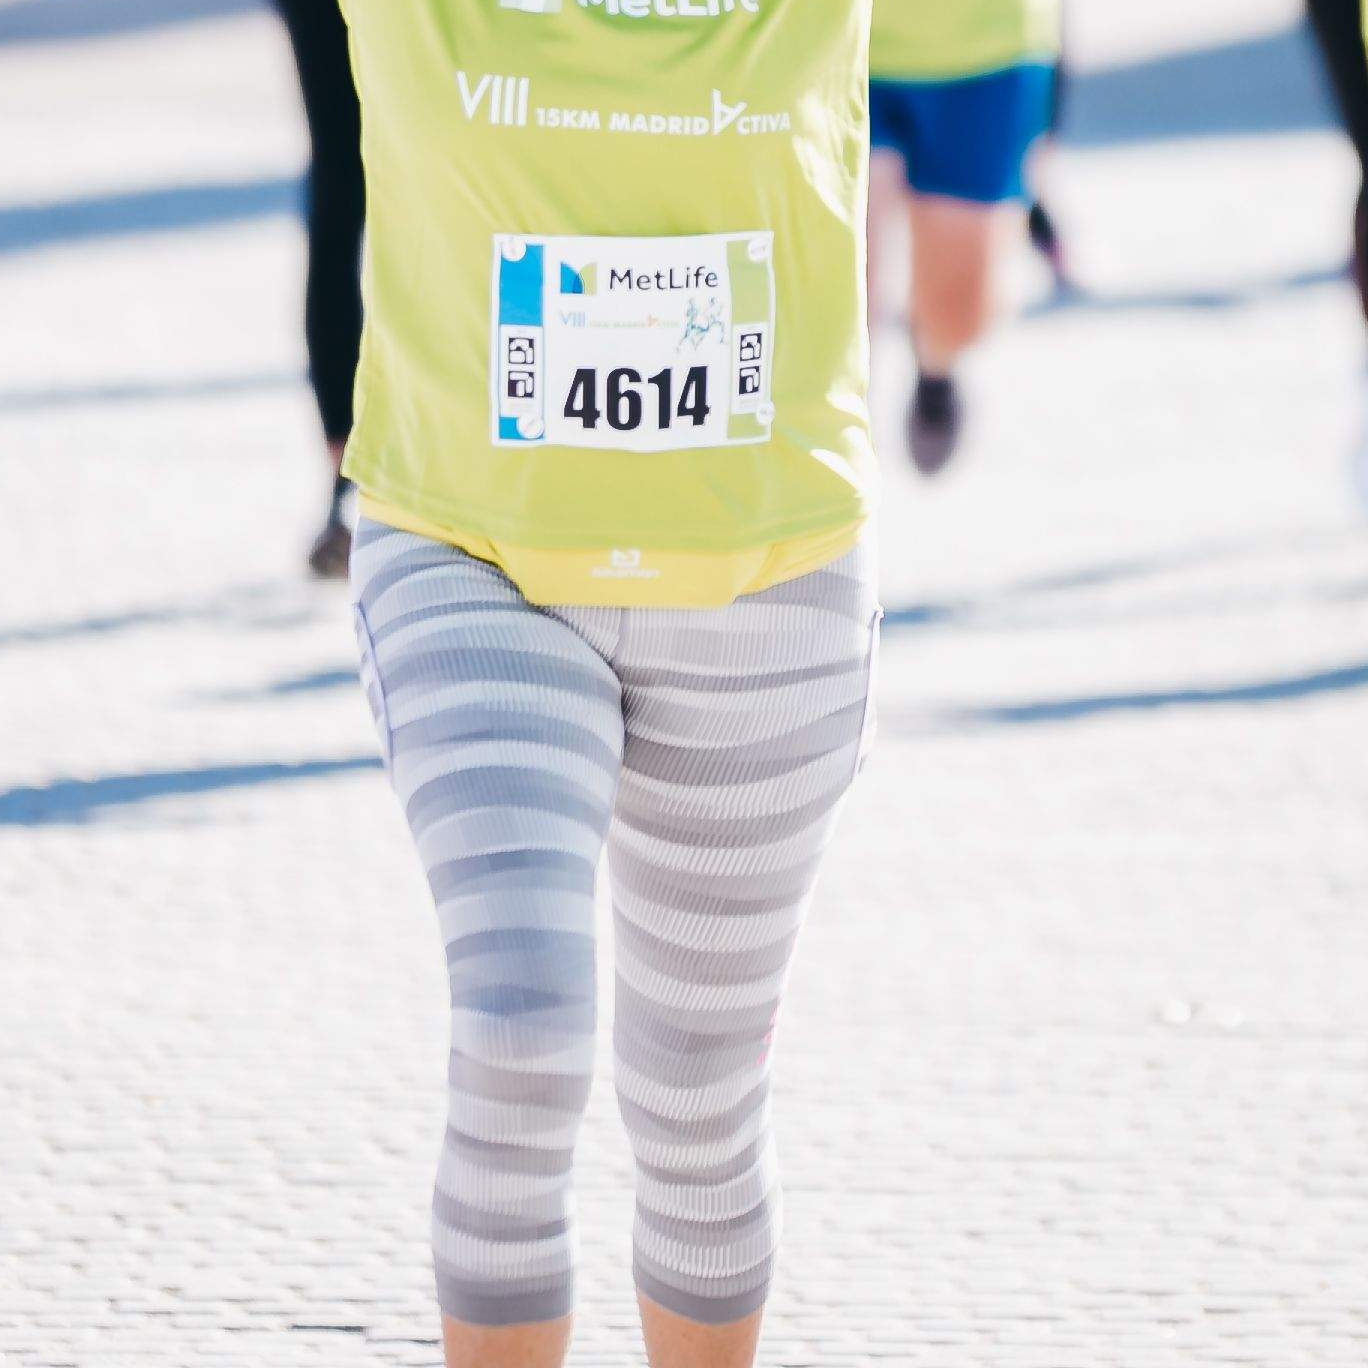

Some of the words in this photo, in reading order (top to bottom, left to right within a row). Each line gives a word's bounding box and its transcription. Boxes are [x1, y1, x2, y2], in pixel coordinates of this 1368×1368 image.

[455, 70, 530, 127] VIII
[535, 107, 601, 130] 15KM
[608, 265, 719, 292] MetLife
[562, 364, 711, 432] 4614
